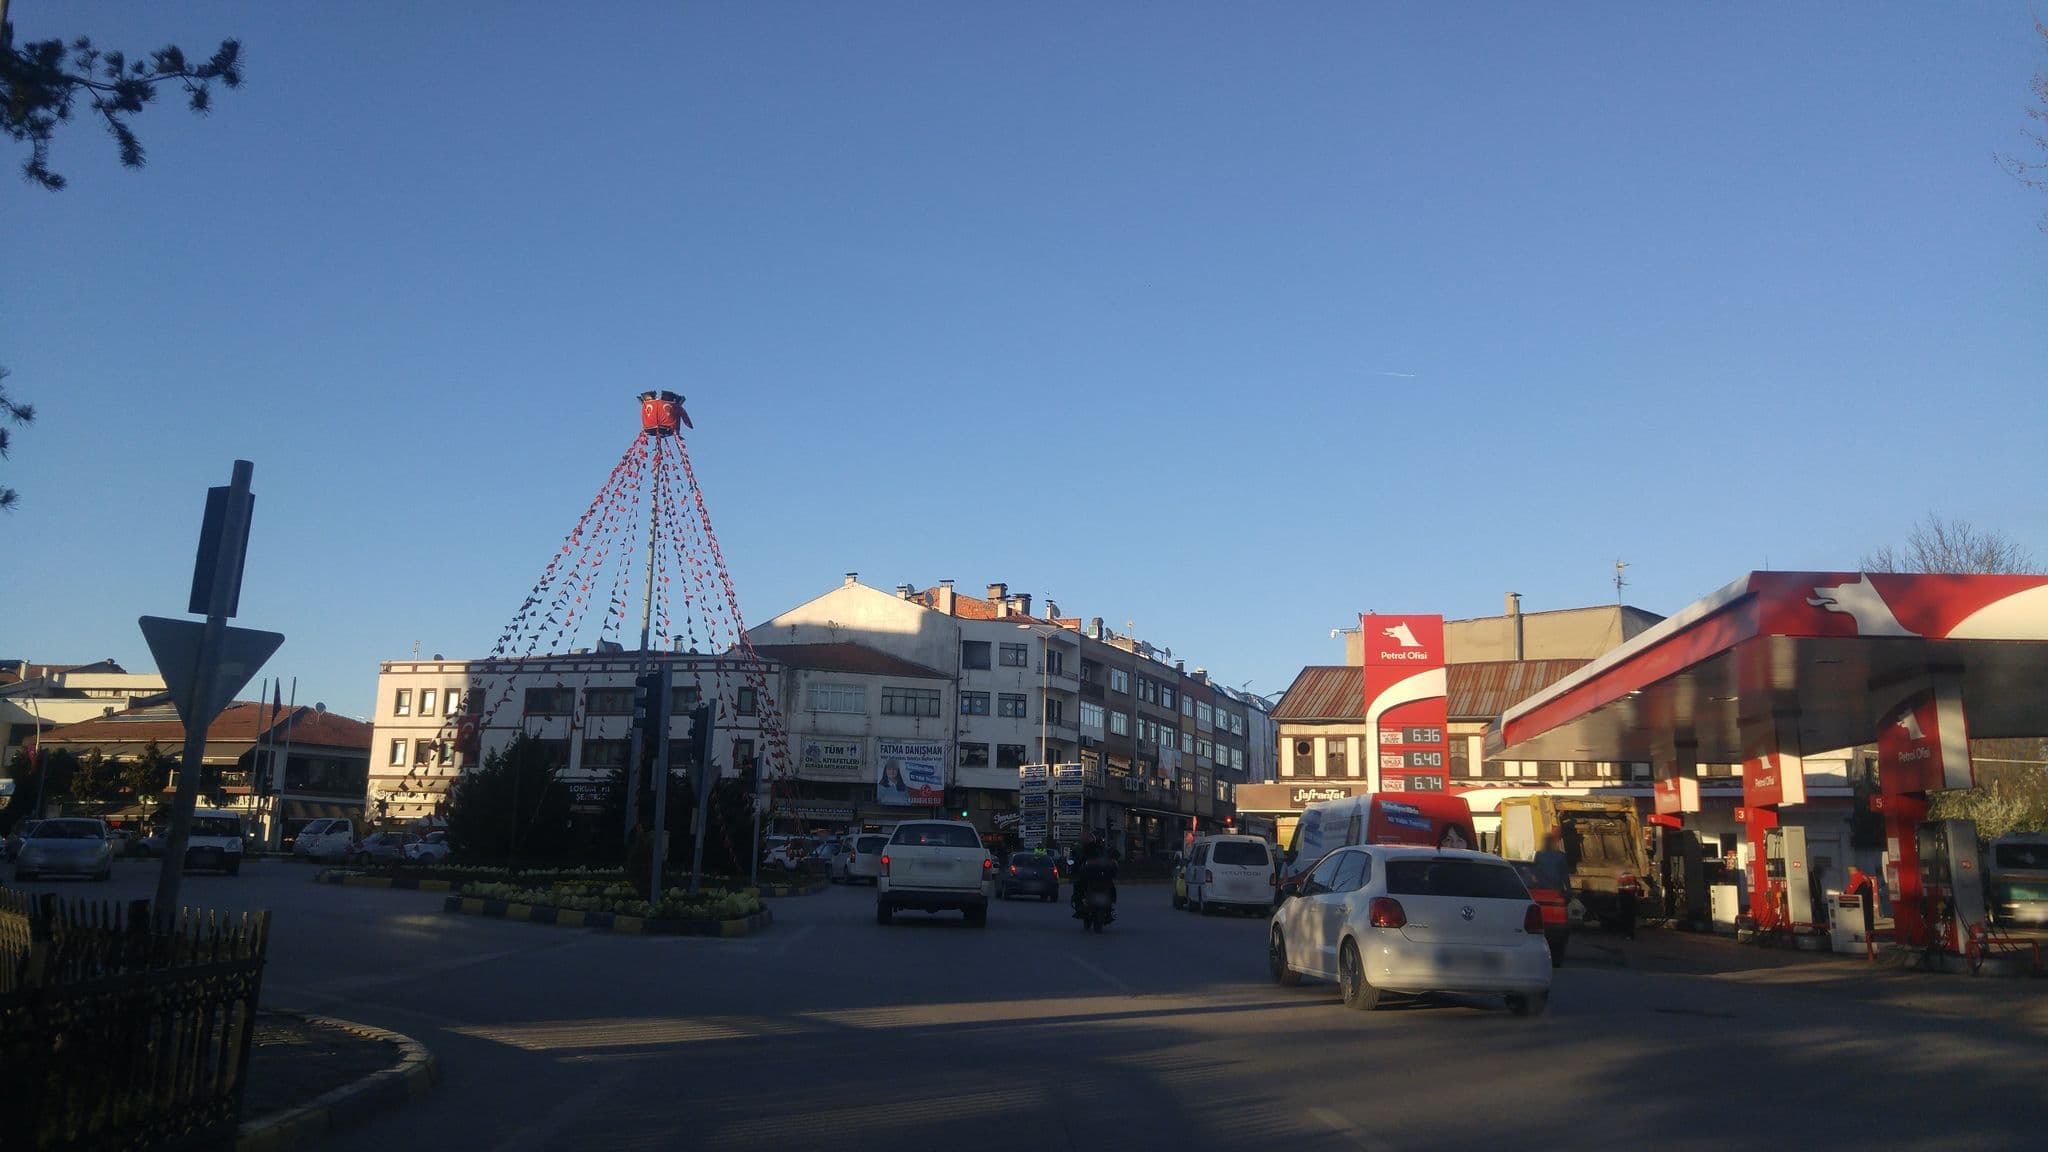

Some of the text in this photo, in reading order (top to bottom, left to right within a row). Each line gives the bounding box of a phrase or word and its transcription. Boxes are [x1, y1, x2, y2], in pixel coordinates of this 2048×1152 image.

[1381, 651, 1428, 660] Petrol Ofisi
[1413, 728, 1440, 742] 6.36
[824, 745, 844, 754] TÜM
[880, 744, 903, 754] FATMA
[1413, 752, 1441, 766] 6.40
[1898, 749, 1915, 762] Petrol
[1414, 776, 1442, 790] 6.74
[1293, 789, 1345, 802] SafranTat
[1876, 798, 1882, 808] 5
[1738, 810, 1744, 819] 3
